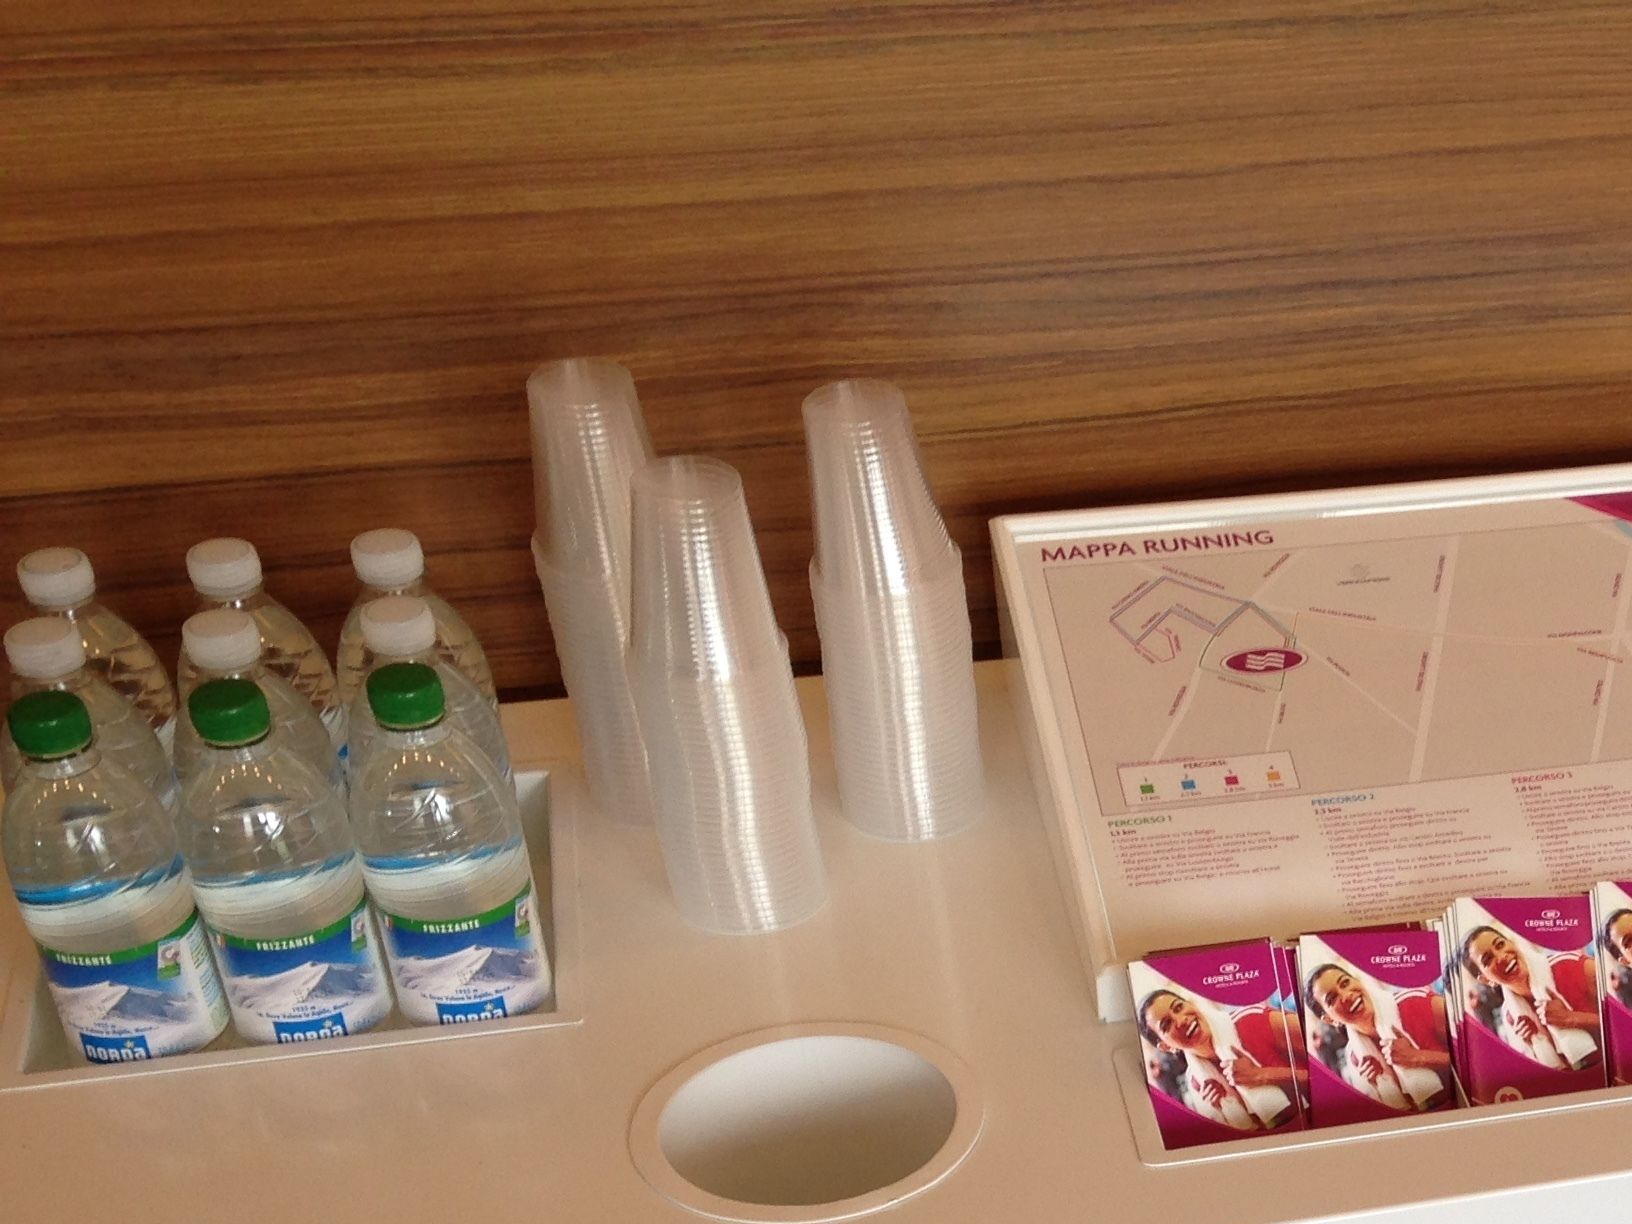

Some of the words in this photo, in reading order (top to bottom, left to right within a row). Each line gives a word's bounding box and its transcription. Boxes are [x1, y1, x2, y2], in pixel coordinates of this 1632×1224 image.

[1041, 541, 1136, 562] MAPPA
[1143, 530, 1274, 554] RUNNING
[1107, 815, 1166, 828] PERCORSO
[423, 919, 480, 934] FRIZZANTE
[1525, 919, 1554, 928] CROWNE
[1557, 919, 1579, 927] PLAZA
[256, 935, 315, 952] FRIZZANTE
[56, 953, 112, 967] FRIZZANTE
[1371, 955, 1401, 965] CROWNE
[1402, 954, 1427, 962] PLAZA
[1202, 974, 1234, 985] CROWNE
[1235, 970, 1259, 980] PLAZA
